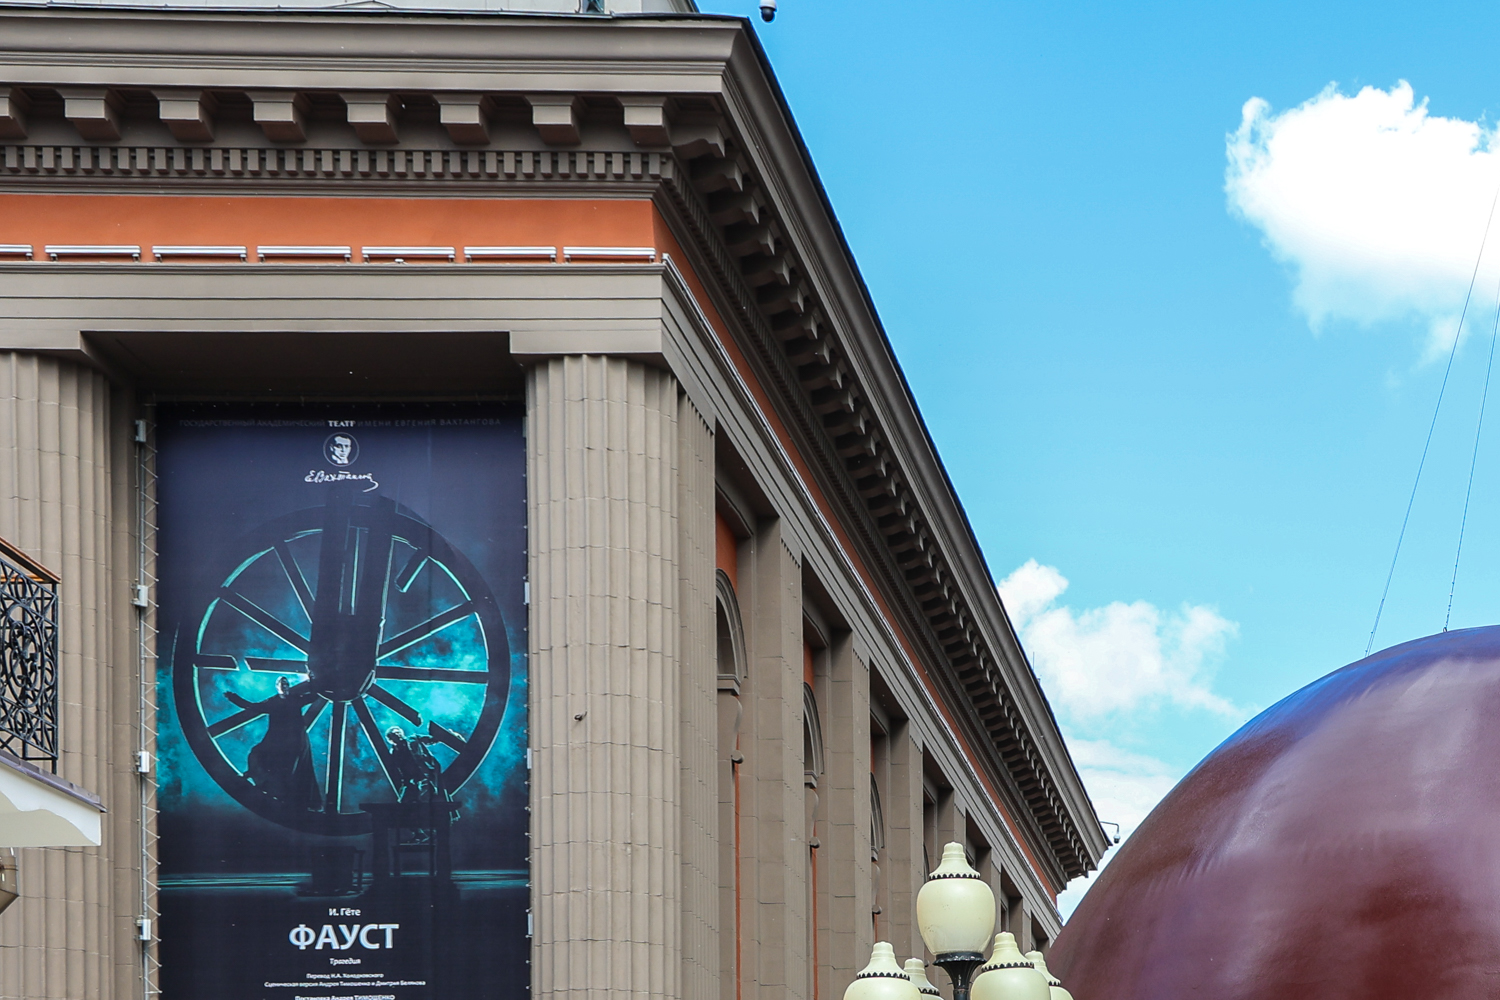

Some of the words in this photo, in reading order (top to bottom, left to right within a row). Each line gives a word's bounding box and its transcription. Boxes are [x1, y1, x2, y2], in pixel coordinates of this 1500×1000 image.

[394, 418, 436, 427] ЕВГЕНИЯ
[439, 418, 501, 426] ВАХТАНГОВА
[328, 908, 339, 916] И.
[340, 907, 361, 916] Гёте
[288, 924, 400, 950] ФАУСТ
[329, 958, 361, 966] Трагедия
